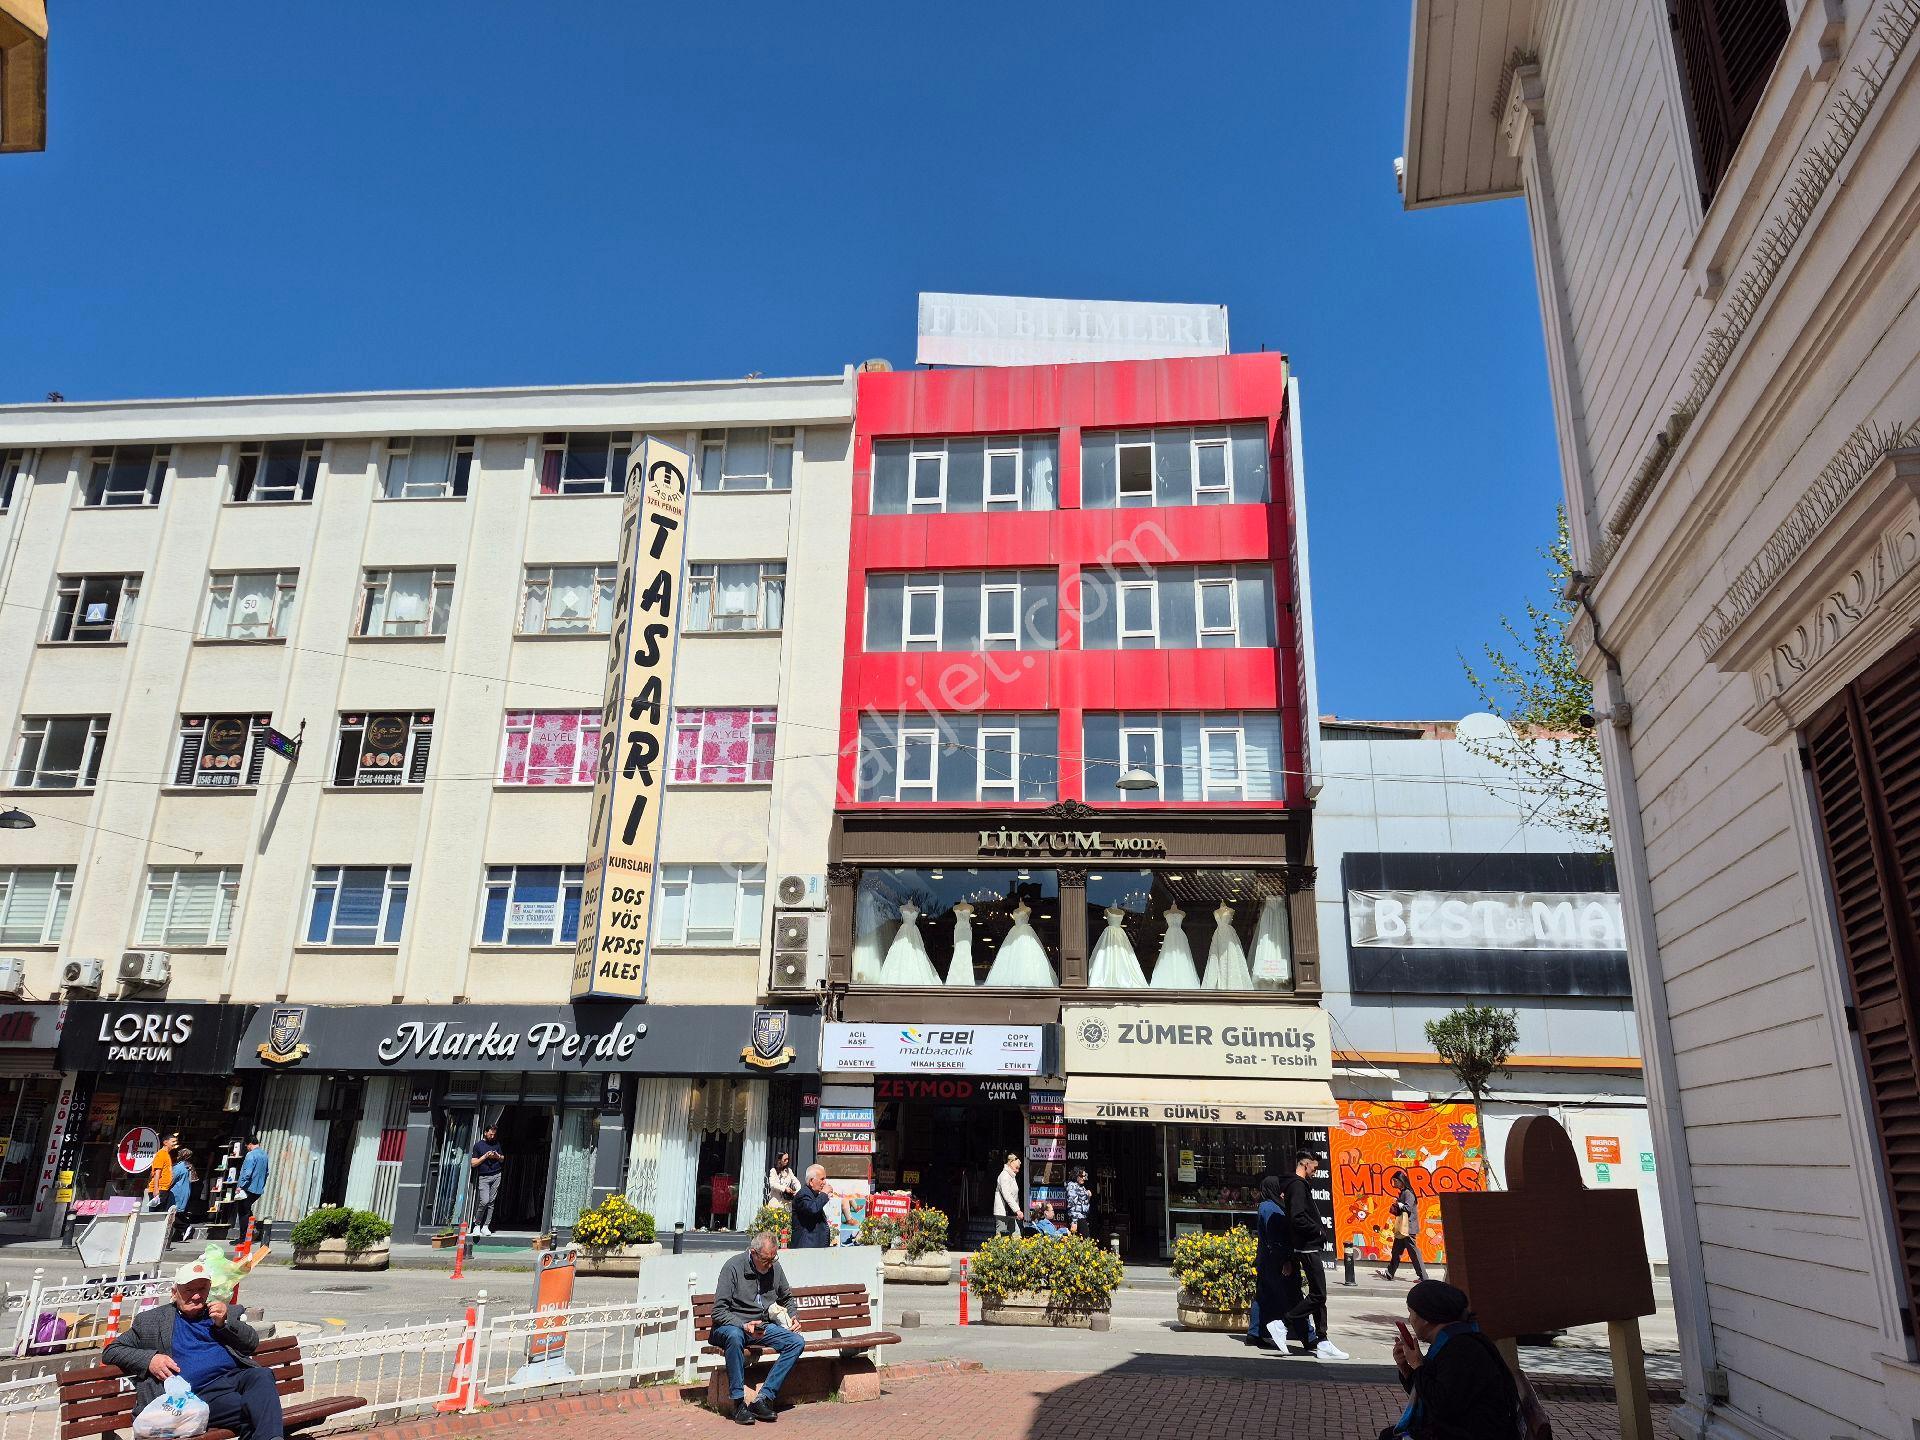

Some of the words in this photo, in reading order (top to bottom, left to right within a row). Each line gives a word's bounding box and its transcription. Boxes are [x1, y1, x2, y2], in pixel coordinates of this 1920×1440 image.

[243, 599, 257, 609] 50
[622, 513, 679, 845] TASARI
[540, 733, 574, 742] ALYEL
[1113, 838, 1168, 851] MODA
[609, 856, 652, 874] KURSLARI
[611, 886, 645, 906] DGS
[610, 909, 642, 930] YÖS
[1374, 900, 1505, 938] BEST
[601, 936, 645, 956] KPSS
[599, 961, 641, 981] ALES
[378, 1021, 520, 1060] Marka
[927, 1029, 974, 1045] reel
[1117, 1020, 1213, 1046] ZÜMER
[1221, 1026, 1316, 1053] Gümüş
[107, 1046, 173, 1062] PARFUM
[1225, 1053, 1257, 1065] Saat
[1271, 1054, 1318, 1067] Tesbih
[877, 1080, 974, 1098] ZEYMOD
[980, 1082, 1023, 1091] AYAKKABI
[988, 1091, 1017, 1101] ÇANTA
[1096, 1104, 1149, 1118] ZÜMER
[1164, 1105, 1219, 1122] GÜMÜŞ
[1235, 1111, 1246, 1121] &
[1264, 1110, 1305, 1123] SAAT
[852, 1133, 870, 1141] LGS
[1304, 1131, 1327, 1142] KOLYE
[1067, 1151, 1089, 1160] ALYANS
